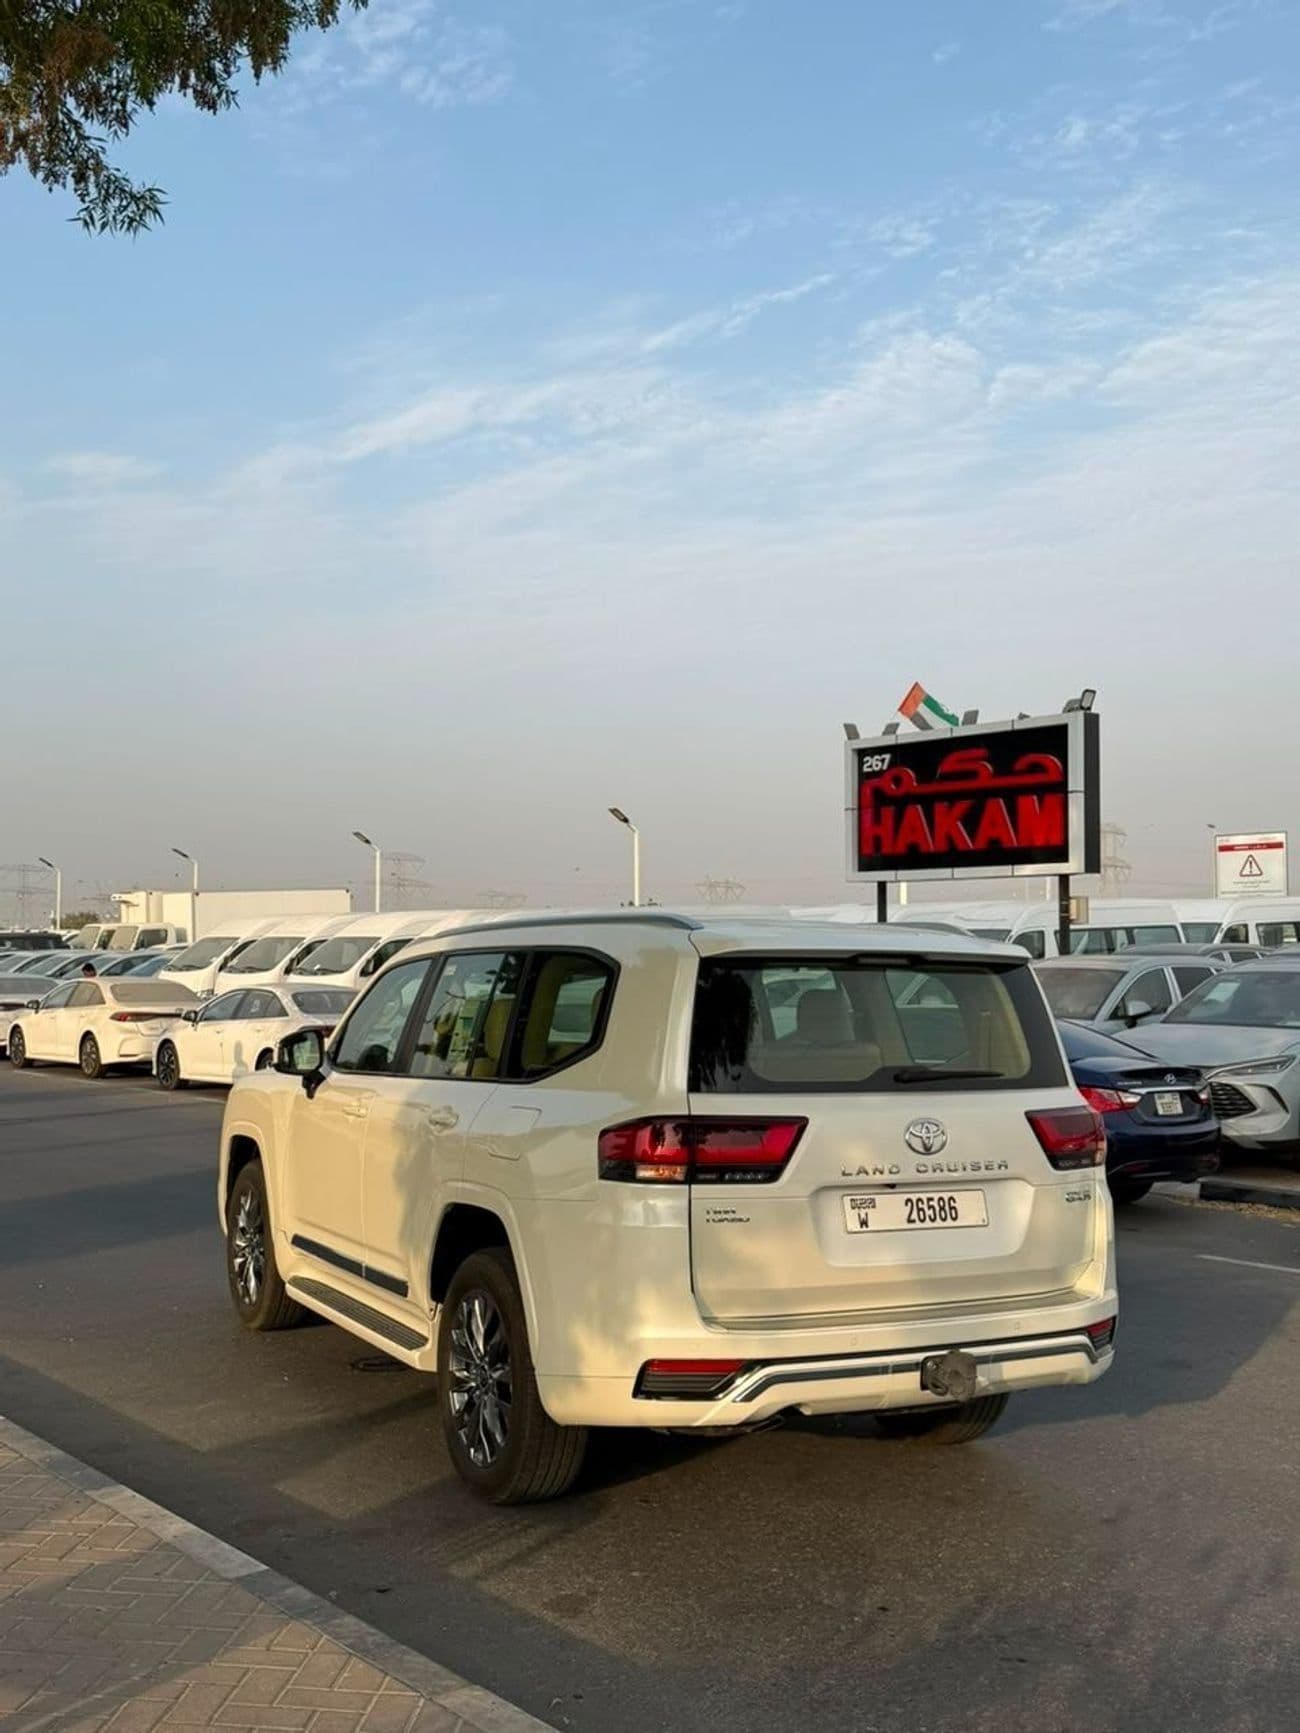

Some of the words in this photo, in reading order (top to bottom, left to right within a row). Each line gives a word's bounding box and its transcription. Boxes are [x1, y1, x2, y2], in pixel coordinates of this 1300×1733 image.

[863, 753, 891, 771] 267
[860, 792, 1065, 857] HAKAM
[841, 1163, 901, 1177] LAND
[915, 1159, 1009, 1174] CRUISER
[904, 1195, 959, 1224] 26586
[857, 1211, 869, 1229] W
